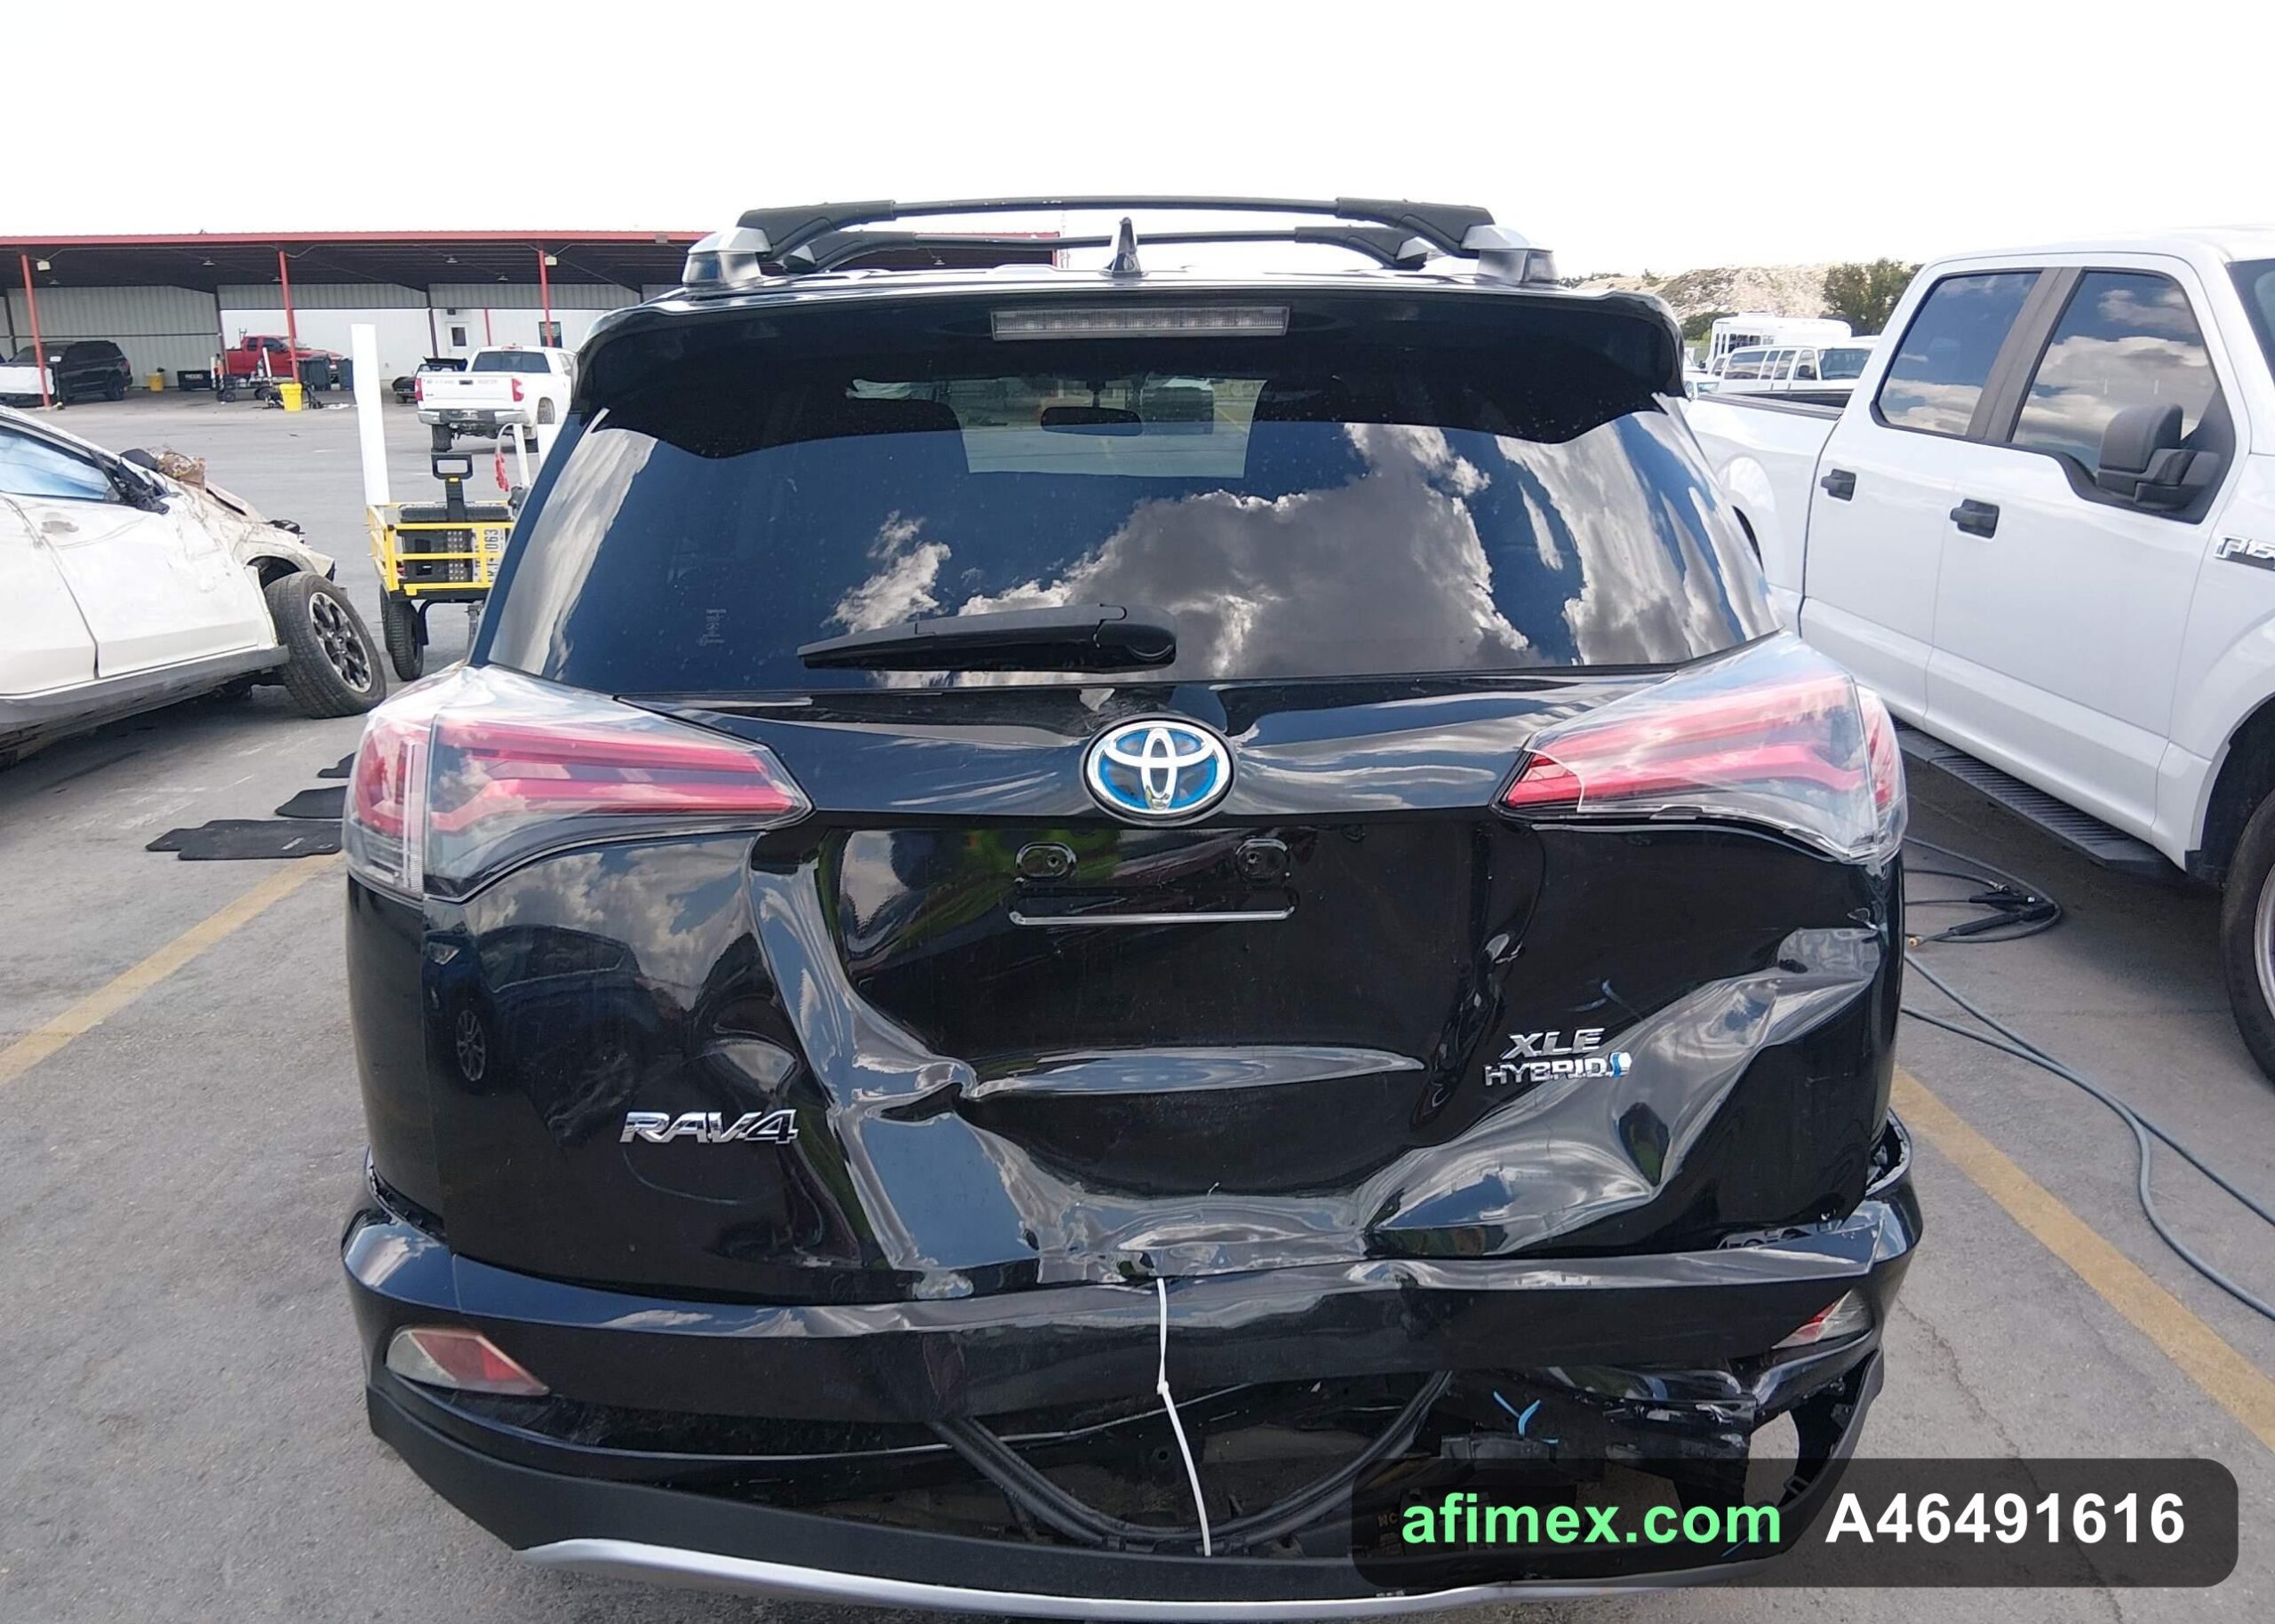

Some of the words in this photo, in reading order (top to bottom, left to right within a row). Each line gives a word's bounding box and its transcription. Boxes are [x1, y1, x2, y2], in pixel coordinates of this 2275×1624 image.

[1499, 1028, 1606, 1060] XLE
[1484, 1056, 1611, 1087] HYBRID
[619, 1109, 799, 1144] RAV4
